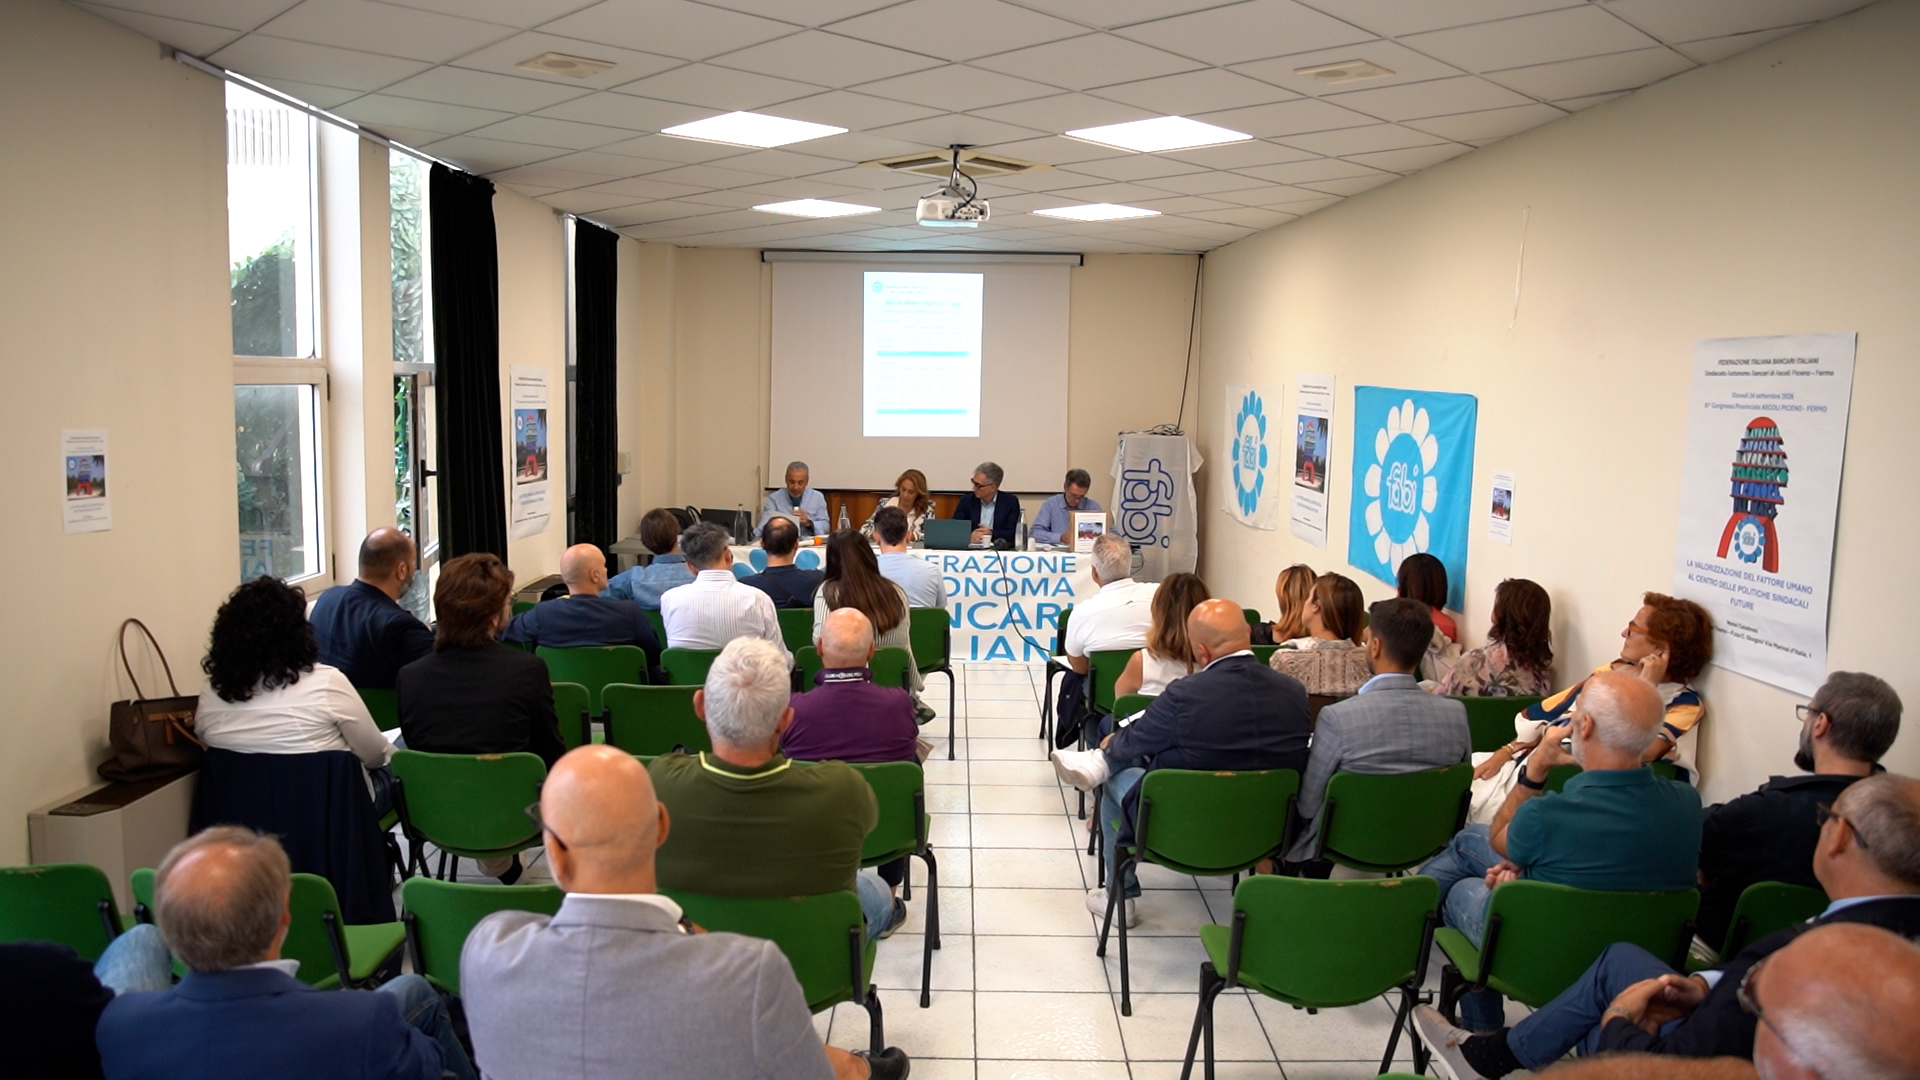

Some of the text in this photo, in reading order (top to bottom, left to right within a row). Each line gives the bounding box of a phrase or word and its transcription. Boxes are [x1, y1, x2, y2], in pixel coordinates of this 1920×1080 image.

[1816, 369, 1834, 377] Fermo
[1762, 403, 1780, 411] ASCOLI
[1782, 404, 1802, 412] PICENO
[1807, 404, 1828, 413] FERMO
[1386, 461, 1419, 515] fabi
[1686, 559, 1813, 595] LA VALORIZZAZIONE DEL FATTORE UMANO
[1688, 573, 1809, 609] AL CENTRO DELLE POLITICHE SINDACALI
[950, 602, 1074, 630] CAR
[1730, 597, 1754, 611] FUTURE
